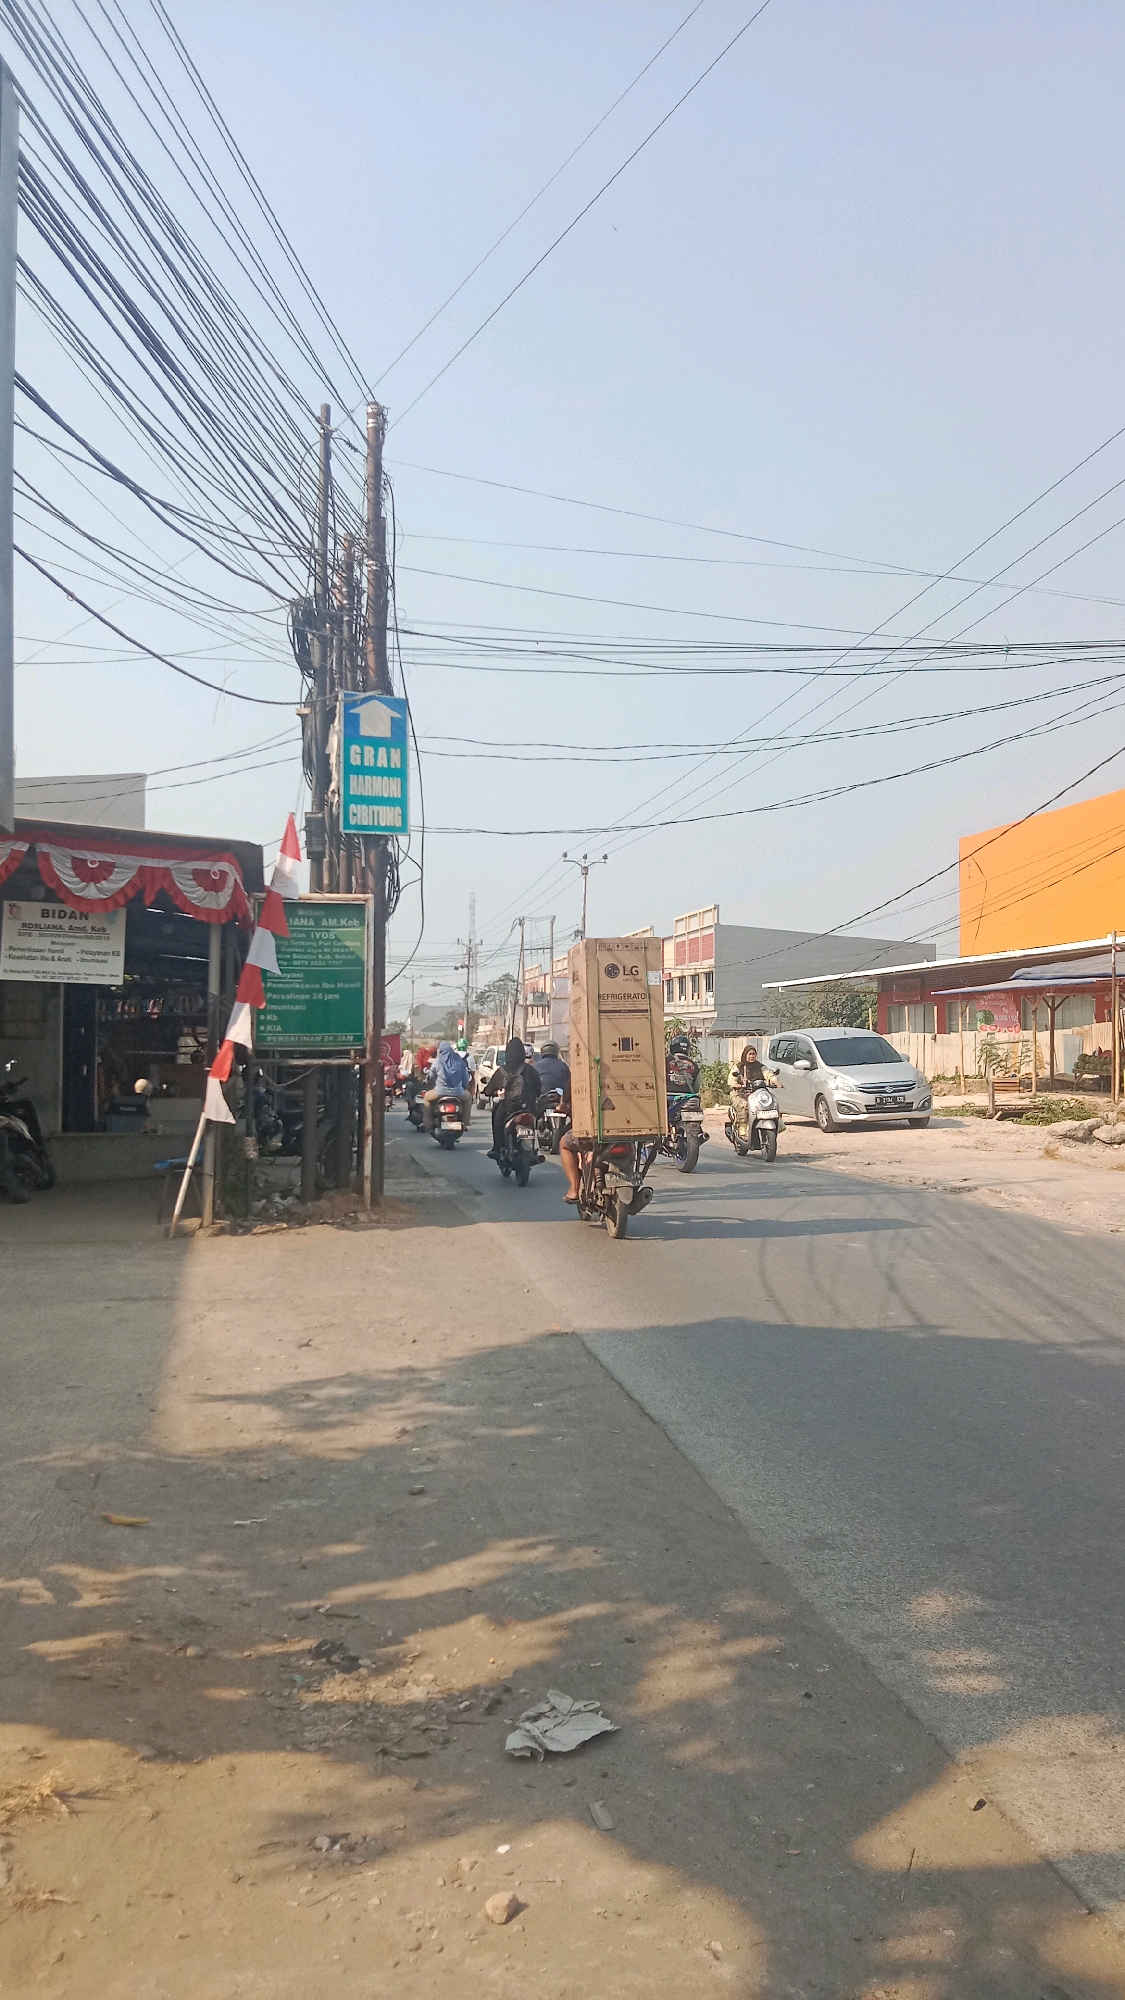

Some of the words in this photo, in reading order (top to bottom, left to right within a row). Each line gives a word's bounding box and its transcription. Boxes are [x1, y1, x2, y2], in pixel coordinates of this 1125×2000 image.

[350, 744, 401, 768] GRAN
[350, 774, 402, 798] HARMONI
[349, 804, 402, 827] CIBITUNG
[40, 908, 90, 920] BIDAN
[321, 918, 360, 927] AM.Keb
[623, 966, 639, 976] LG
